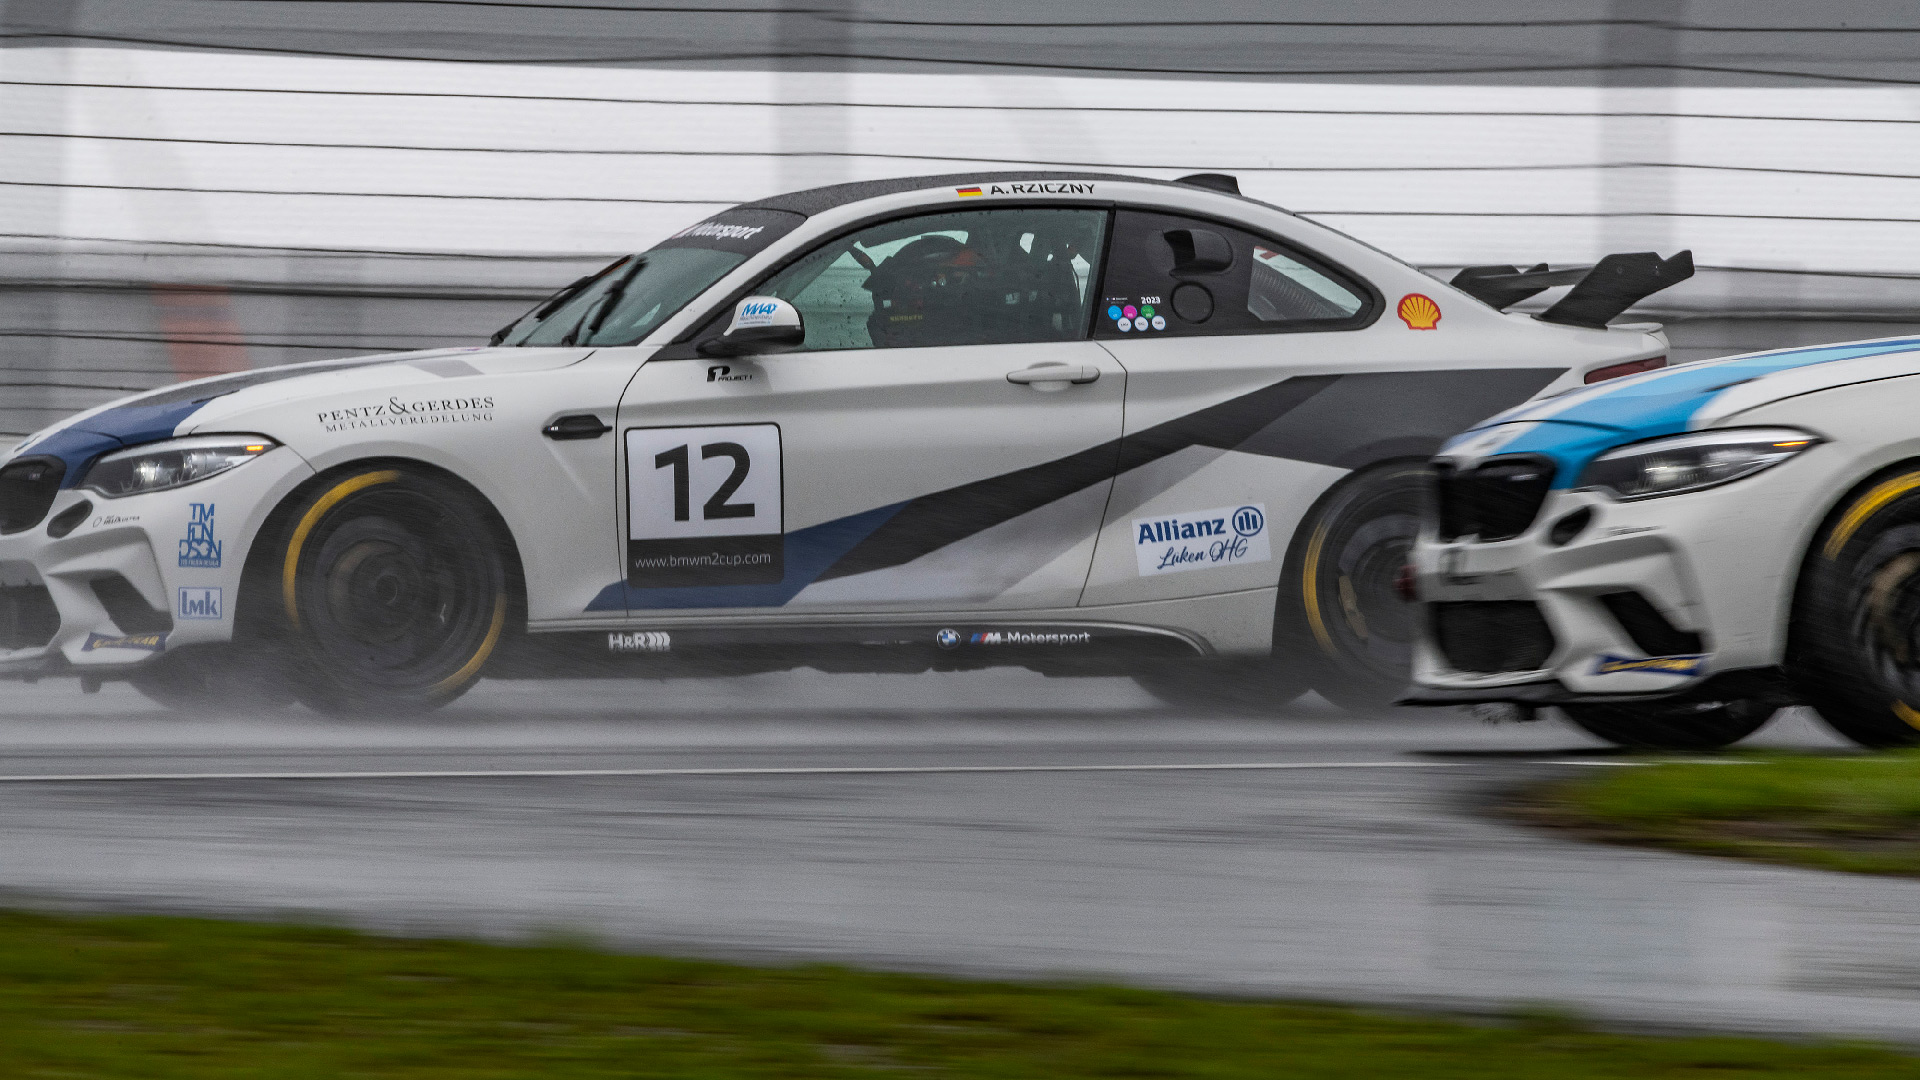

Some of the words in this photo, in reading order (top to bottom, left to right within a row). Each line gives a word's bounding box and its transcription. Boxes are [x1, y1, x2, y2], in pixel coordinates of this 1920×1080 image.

[1140, 296, 1161, 304] 2023
[325, 412, 494, 433] METALLVEREDELUNG
[655, 442, 756, 522] 12
[1138, 518, 1226, 545] Allianz
[635, 552, 771, 569] www.bmwm2cup.com
[608, 631, 647, 651] H&R
